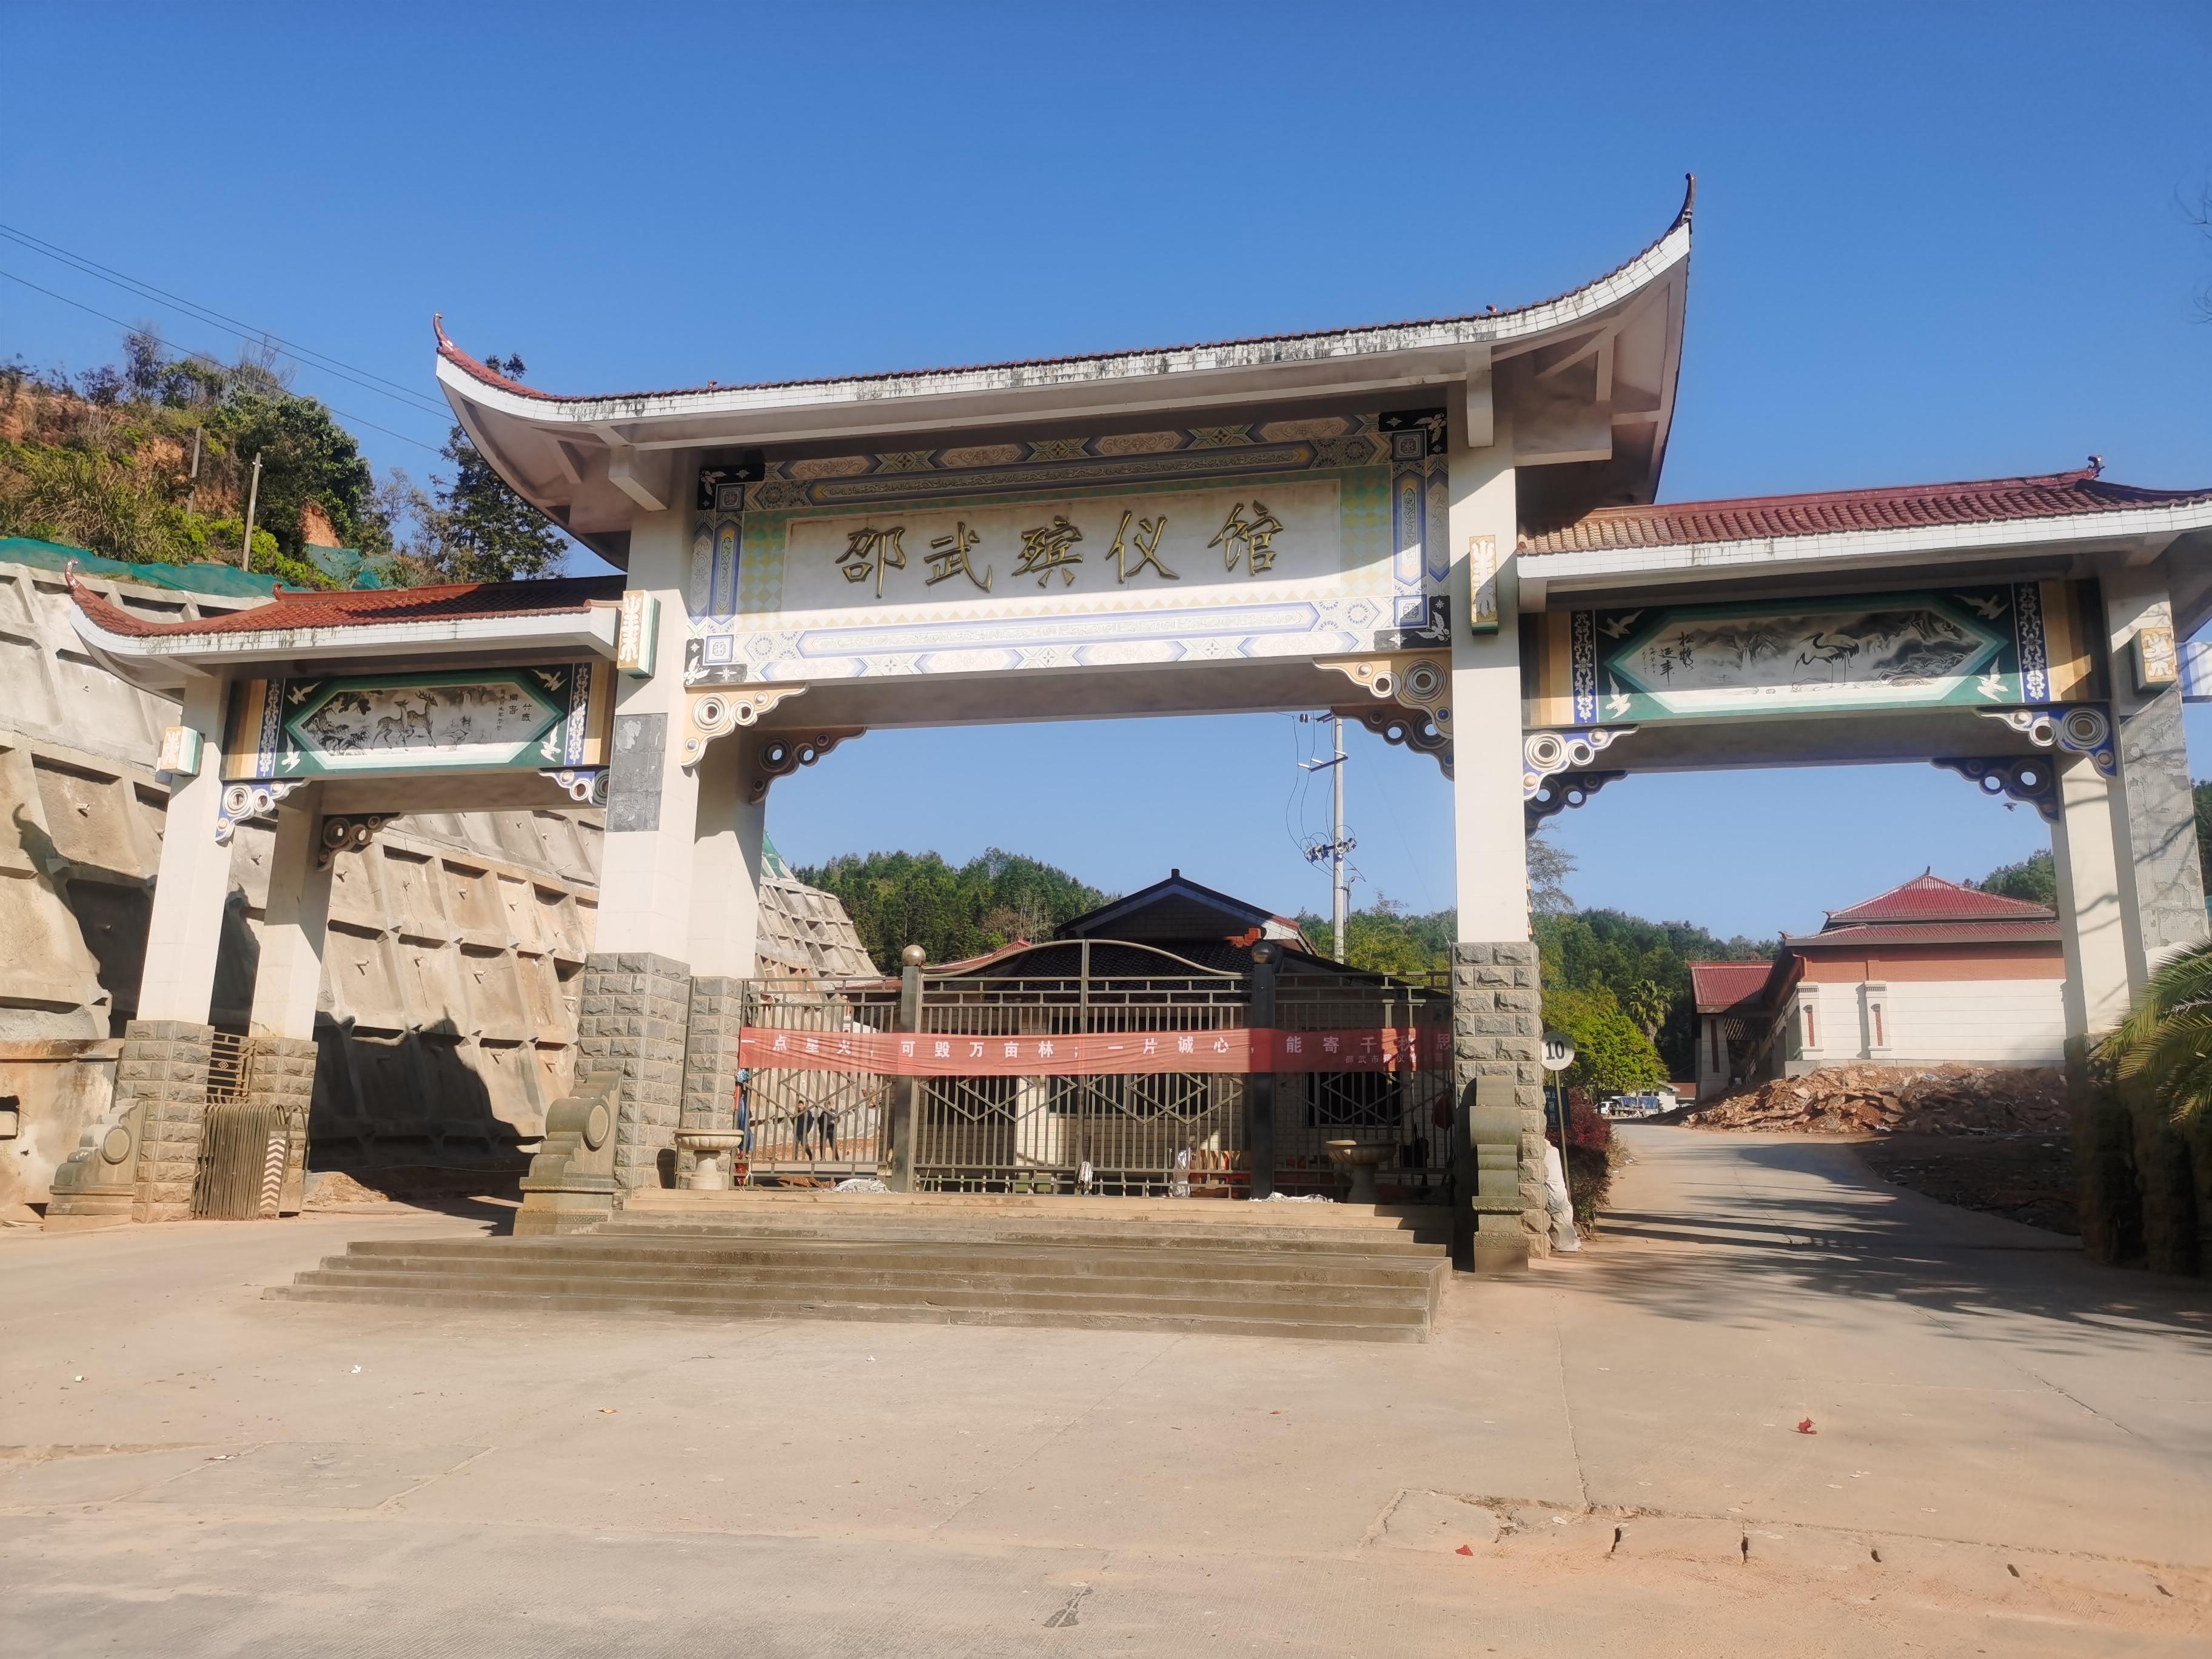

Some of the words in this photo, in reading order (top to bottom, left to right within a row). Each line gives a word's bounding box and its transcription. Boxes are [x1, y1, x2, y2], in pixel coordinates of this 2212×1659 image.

[834, 499, 1286, 599] 邵武殡仪馆
[1546, 1040, 1565, 1060] 10
